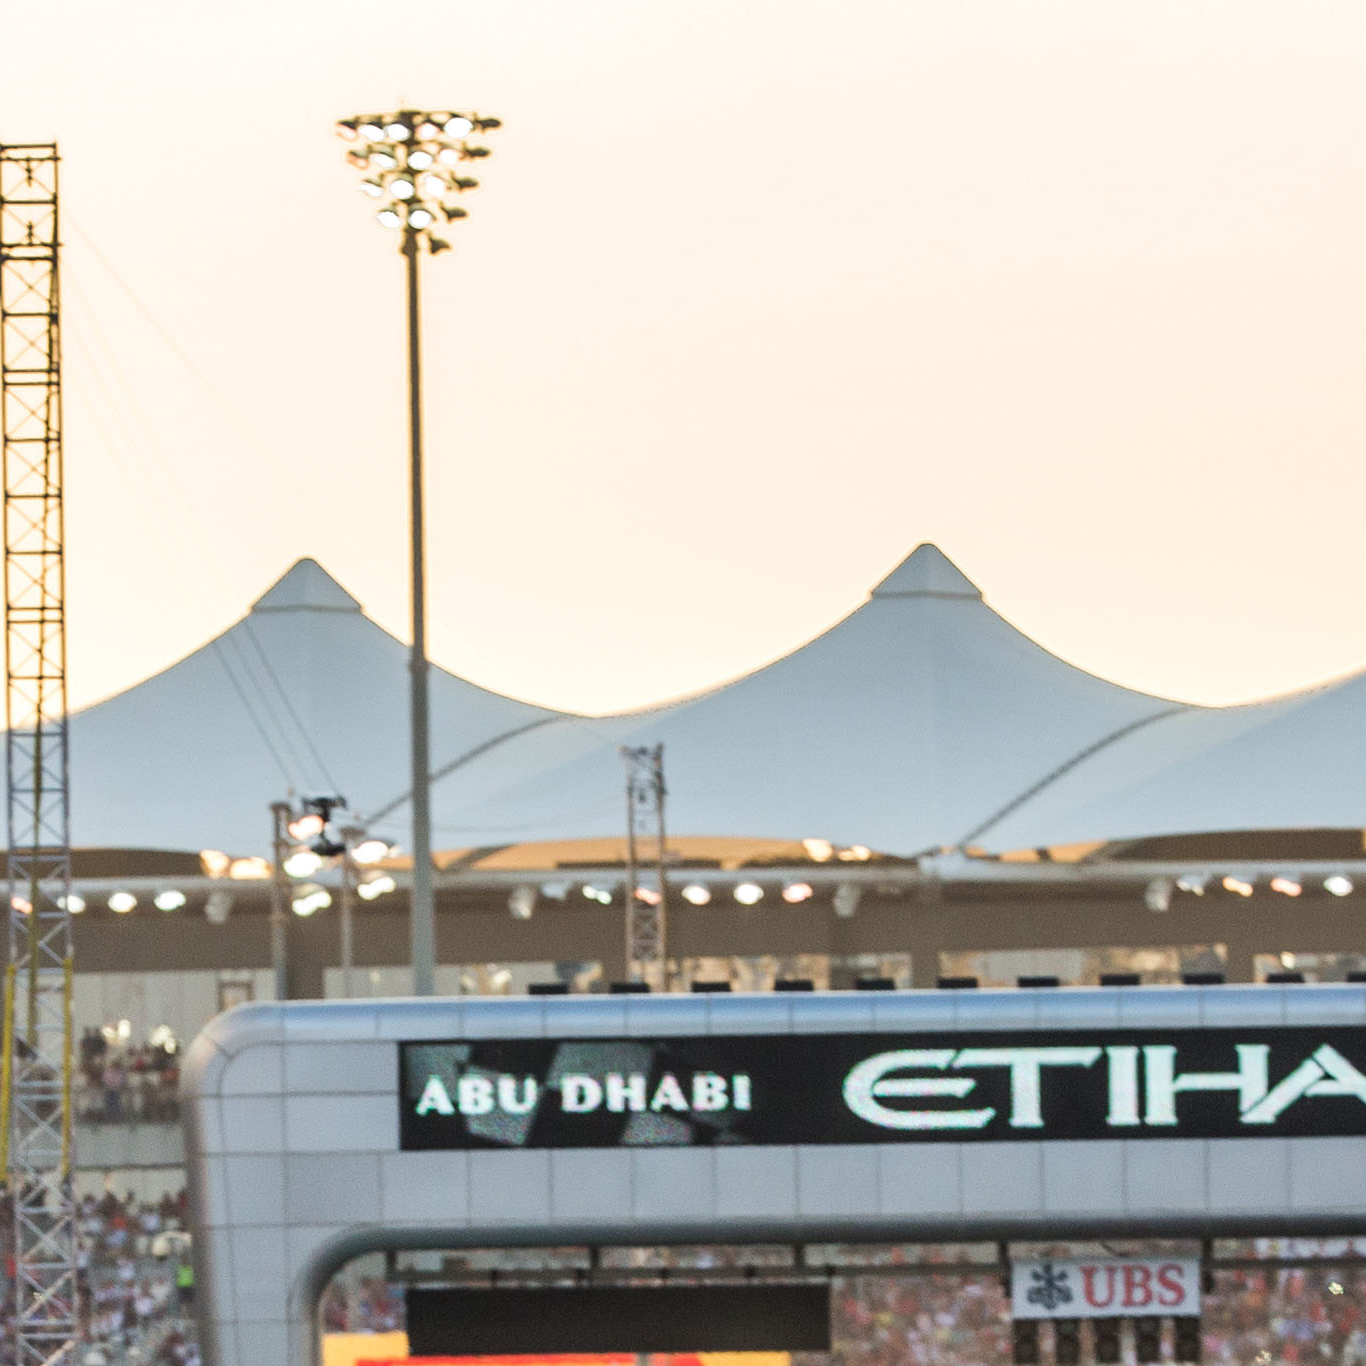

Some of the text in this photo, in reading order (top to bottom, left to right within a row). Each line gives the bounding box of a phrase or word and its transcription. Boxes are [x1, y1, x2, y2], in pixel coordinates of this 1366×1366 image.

[416, 1072, 753, 1117] ABU DHABI
[1080, 1262, 1186, 1308] UBS
